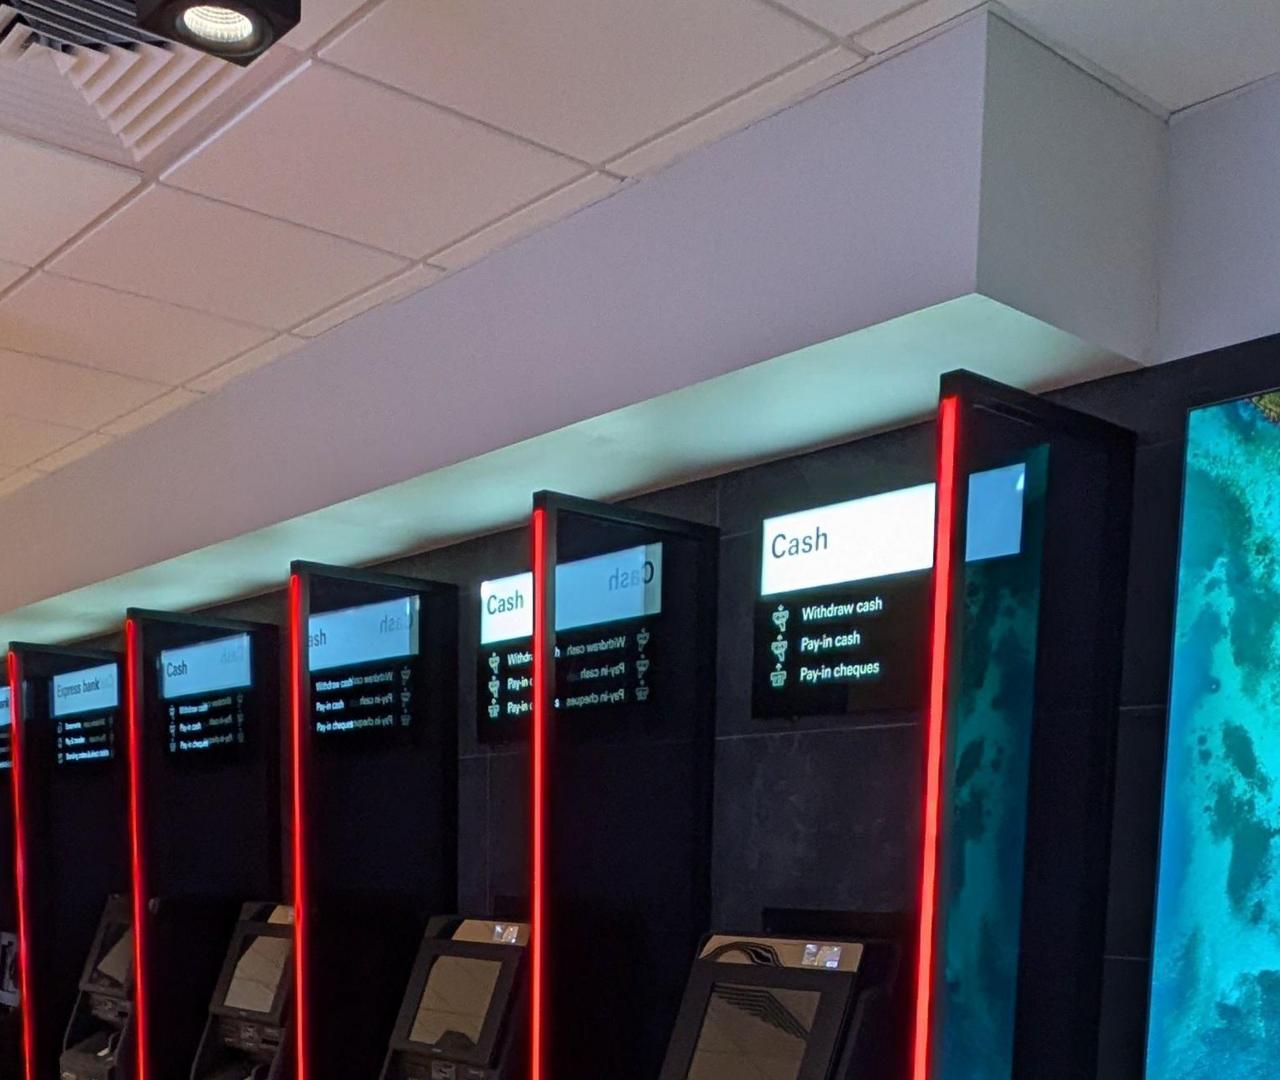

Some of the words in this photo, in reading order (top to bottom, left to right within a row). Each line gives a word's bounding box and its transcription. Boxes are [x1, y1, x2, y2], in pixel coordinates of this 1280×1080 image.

[771, 526, 828, 559] Cash
[487, 589, 524, 615] Cash
[802, 601, 855, 621] Withdraw
[856, 597, 883, 613] cash
[308, 628, 327, 648] ash
[801, 634, 833, 652] Pay-in
[835, 630, 860, 647] cash
[166, 660, 188, 677] Cash
[507, 651, 533, 666] Withdr
[800, 665, 831, 682] Pay-in
[833, 662, 880, 678] cheques
[83, 677, 100, 693] bank
[507, 676, 529, 691] Pay-in
[507, 698, 529, 715] Pay-in
